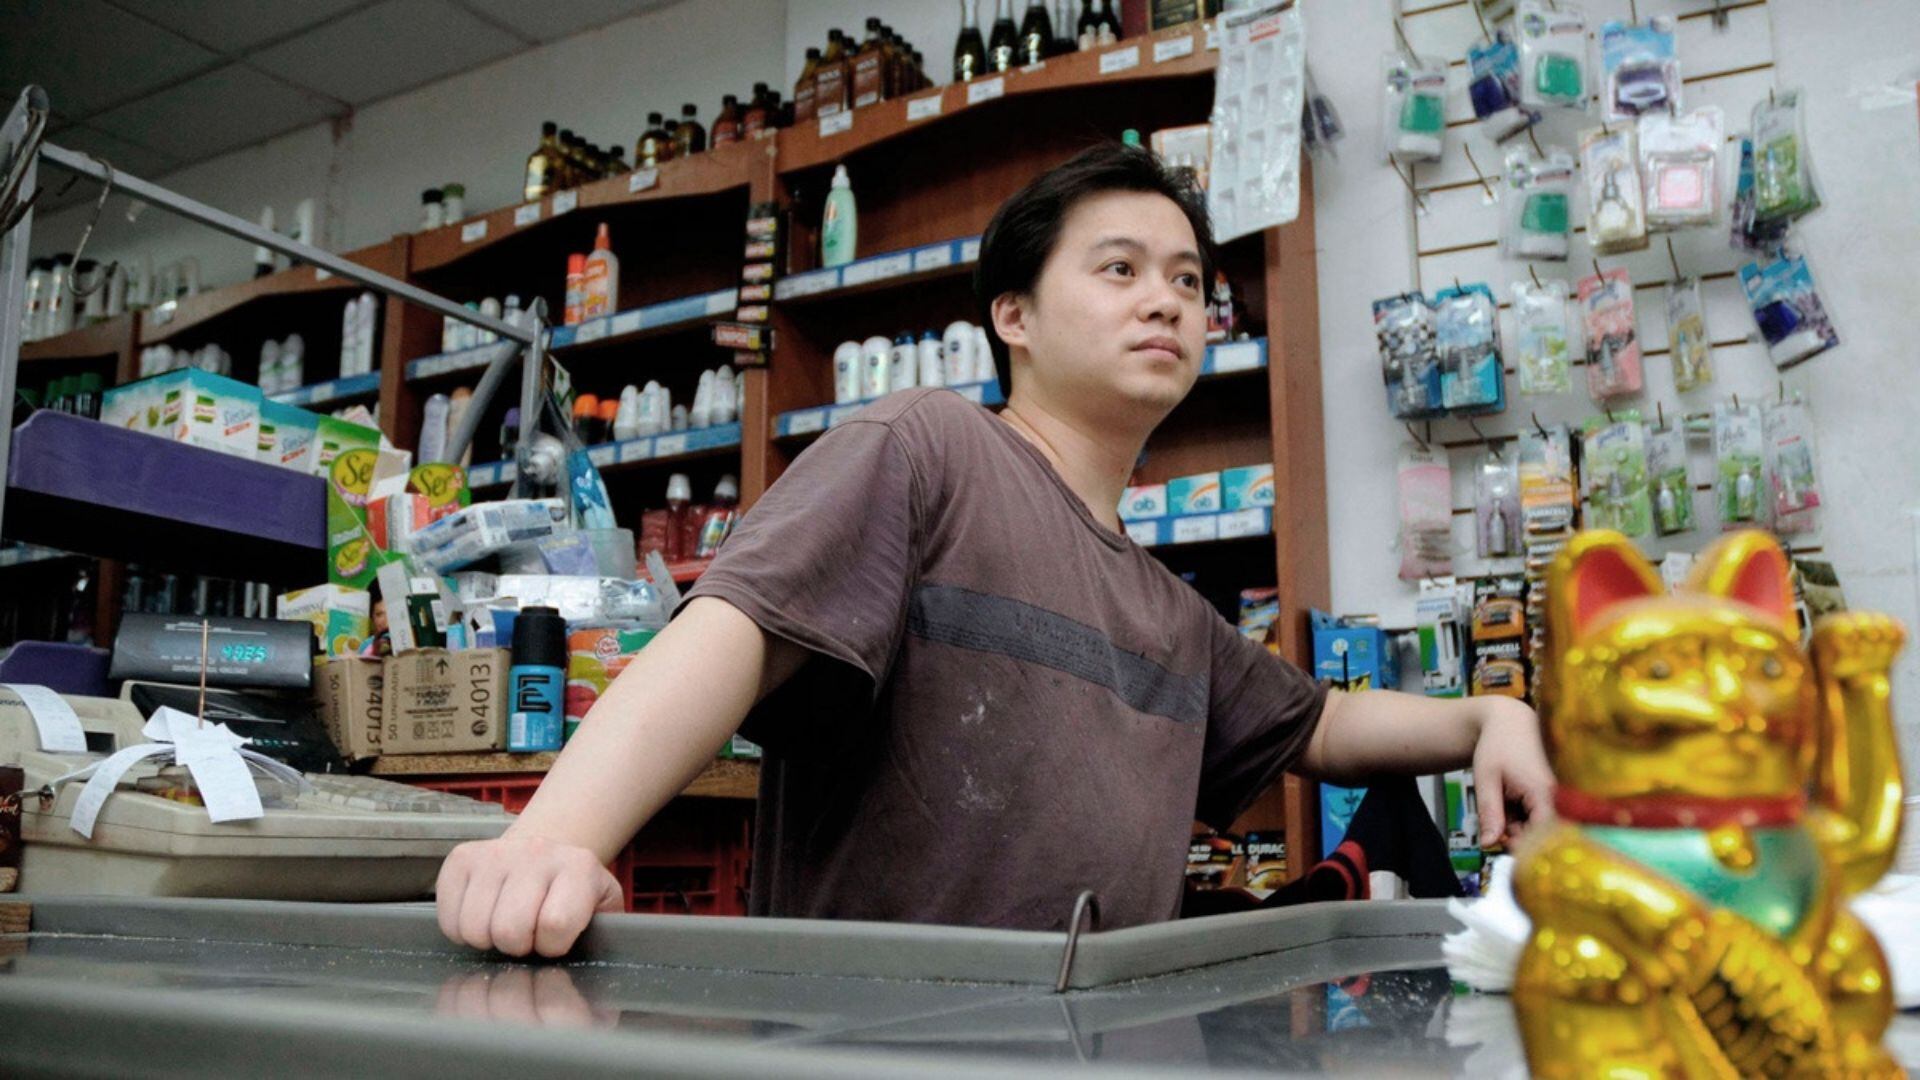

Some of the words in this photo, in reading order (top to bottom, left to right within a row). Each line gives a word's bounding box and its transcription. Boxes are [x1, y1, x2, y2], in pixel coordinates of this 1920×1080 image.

[341, 454, 374, 487] Se
[1476, 643, 1520, 656] DURACELL
[470, 663, 492, 718] 4013
[388, 724, 397, 740] 50
[1248, 843, 1286, 855] DURAC
